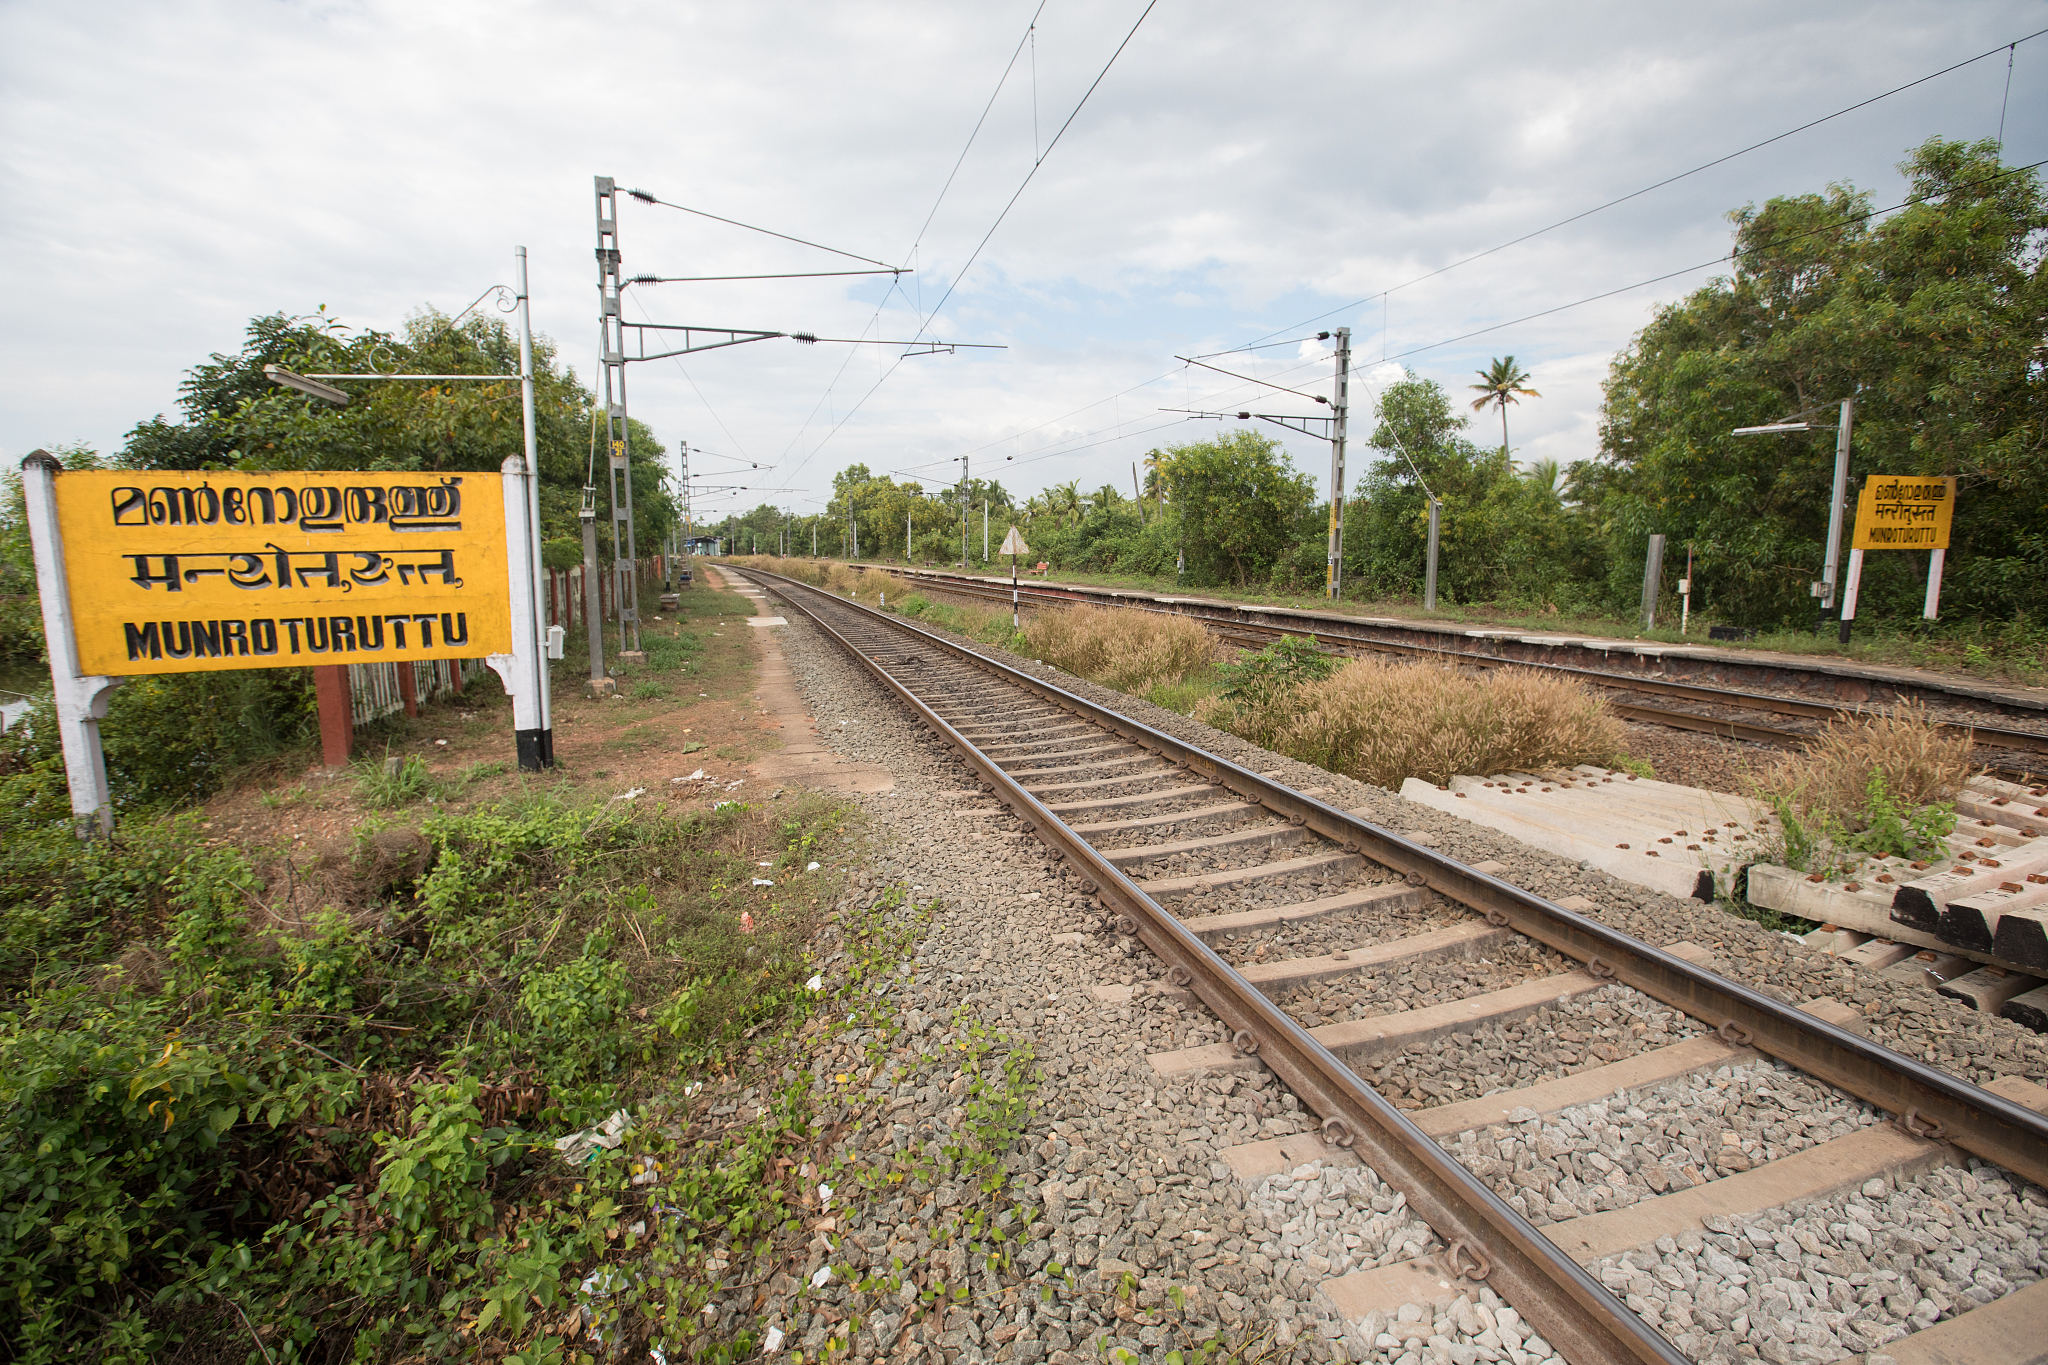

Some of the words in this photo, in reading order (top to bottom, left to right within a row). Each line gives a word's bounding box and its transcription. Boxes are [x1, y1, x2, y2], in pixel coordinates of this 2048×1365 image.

[615, 448, 622, 456] 21
[1868, 527, 1937, 543] MUNROTURUTTU
[124, 612, 468, 660] MUNROTURUTTU
